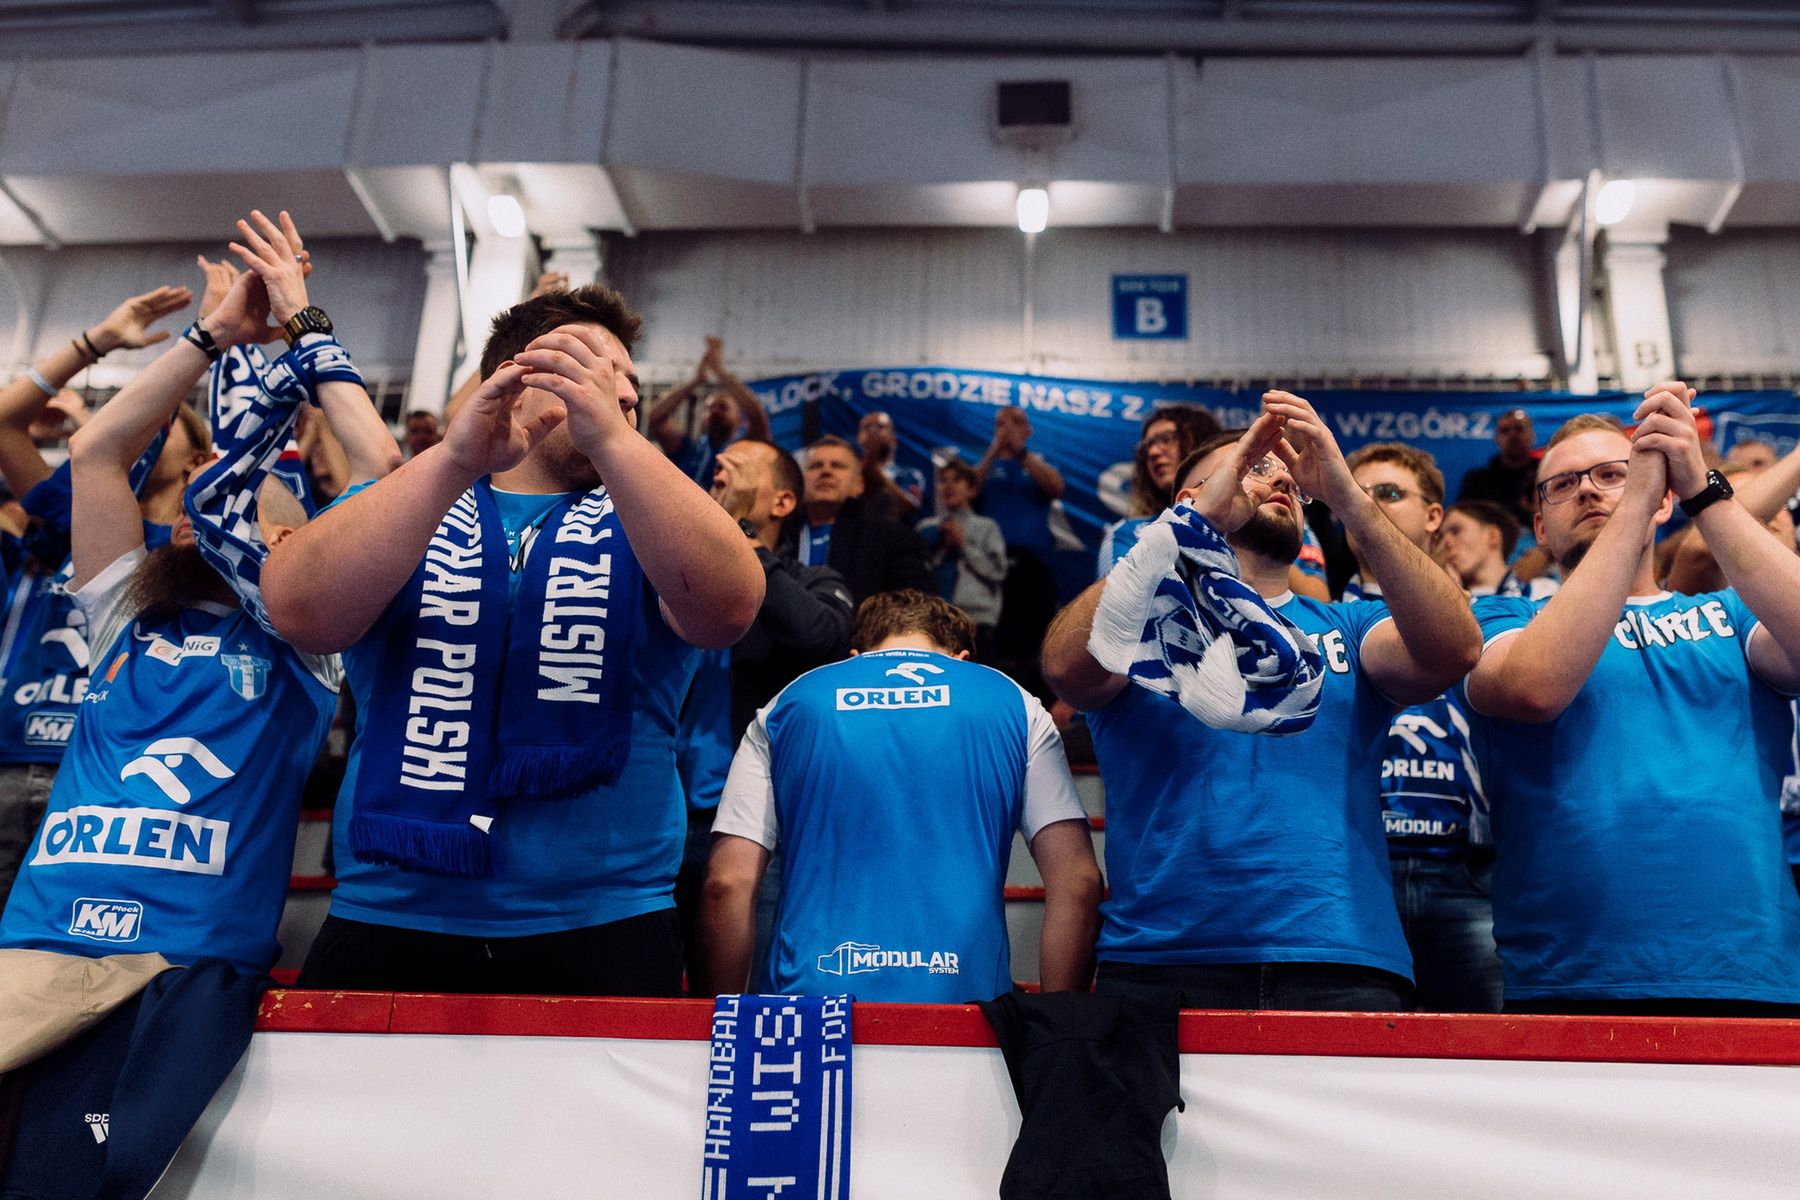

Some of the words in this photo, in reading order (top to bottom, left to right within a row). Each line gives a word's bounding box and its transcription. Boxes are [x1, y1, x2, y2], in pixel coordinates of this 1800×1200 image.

[1135, 297, 1168, 334] B
[862, 371, 1012, 406] GRODZIE
[1018, 382, 1112, 418] NASZ
[555, 484, 615, 545] POL
[537, 553, 612, 704] MISTRZ
[400, 637, 477, 791] POLSKI
[843, 689, 942, 706] ORLEN
[46, 814, 214, 865] ORLEN
[75, 903, 138, 938] KM
[853, 950, 959, 968] MODULAR
[928, 967, 959, 975] SYSTEM
[821, 994, 848, 1064] FOR
[704, 994, 741, 1160] HANDBAL
[750, 994, 804, 1132] WIS
